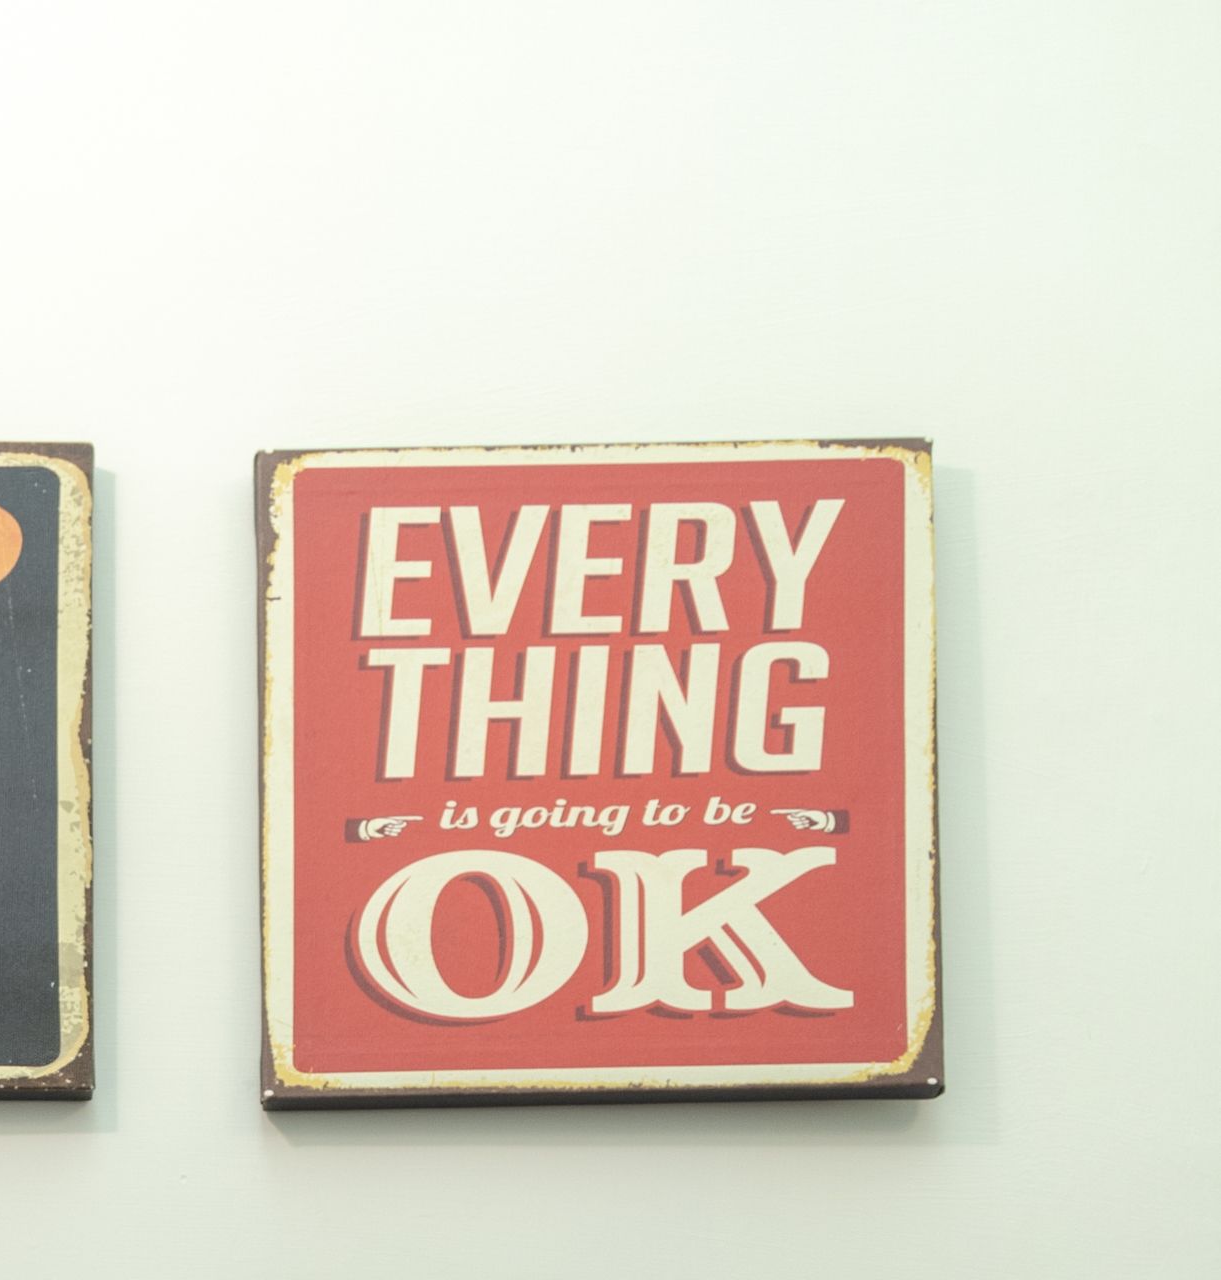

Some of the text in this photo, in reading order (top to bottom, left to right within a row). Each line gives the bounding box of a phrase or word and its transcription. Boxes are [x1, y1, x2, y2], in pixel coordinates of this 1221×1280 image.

[352, 499, 846, 638] EVERY
[359, 641, 830, 781] THING
[439, 796, 756, 837] is going to be
[346, 846, 854, 1026] OK
